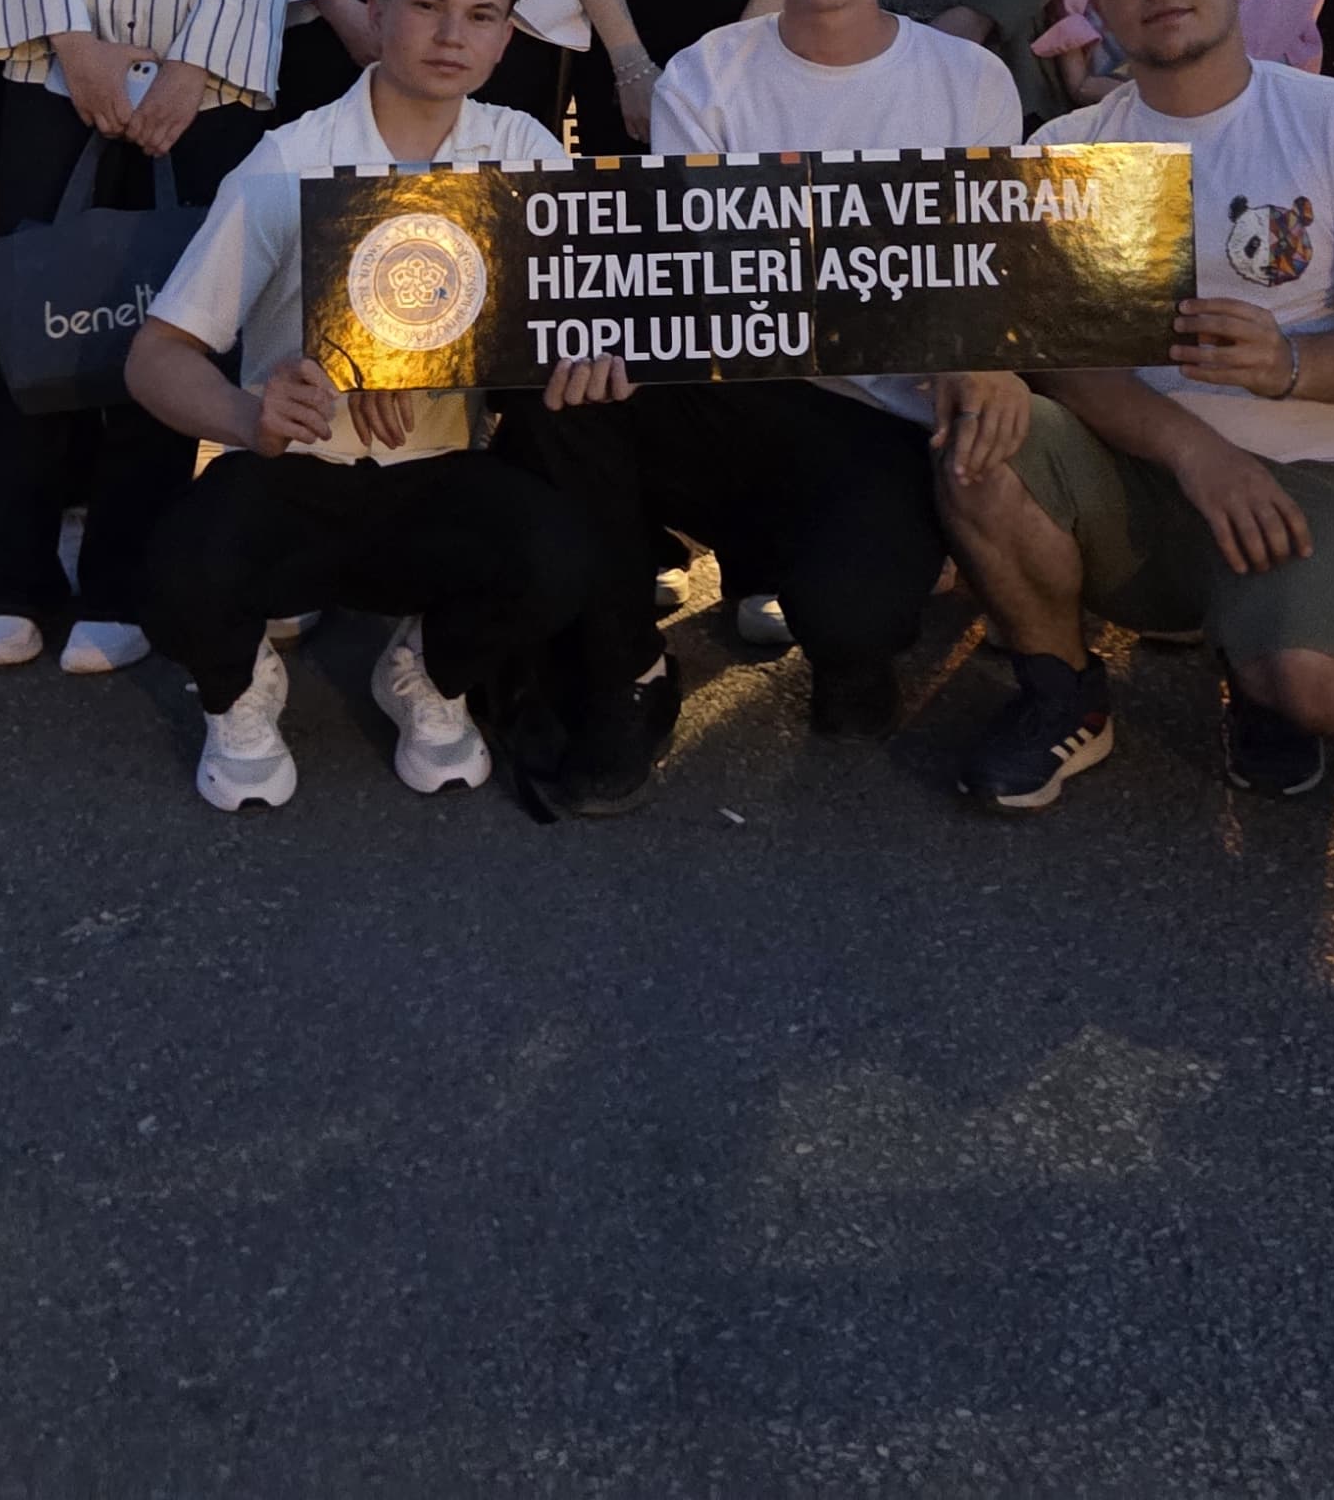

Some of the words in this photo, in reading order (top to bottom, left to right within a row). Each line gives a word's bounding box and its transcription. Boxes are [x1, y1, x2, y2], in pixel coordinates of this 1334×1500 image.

[525, 189, 642, 237] OTEL
[656, 183, 872, 233] LOKANTA
[880, 180, 942, 226] VE
[953, 169, 1101, 224] İKRAM
[527, 237, 803, 301] HİZMETLERİ
[816, 242, 1000, 303] AŞÇILIK
[44, 283, 155, 339] benett
[526, 300, 811, 365] TOPLULUĞU
